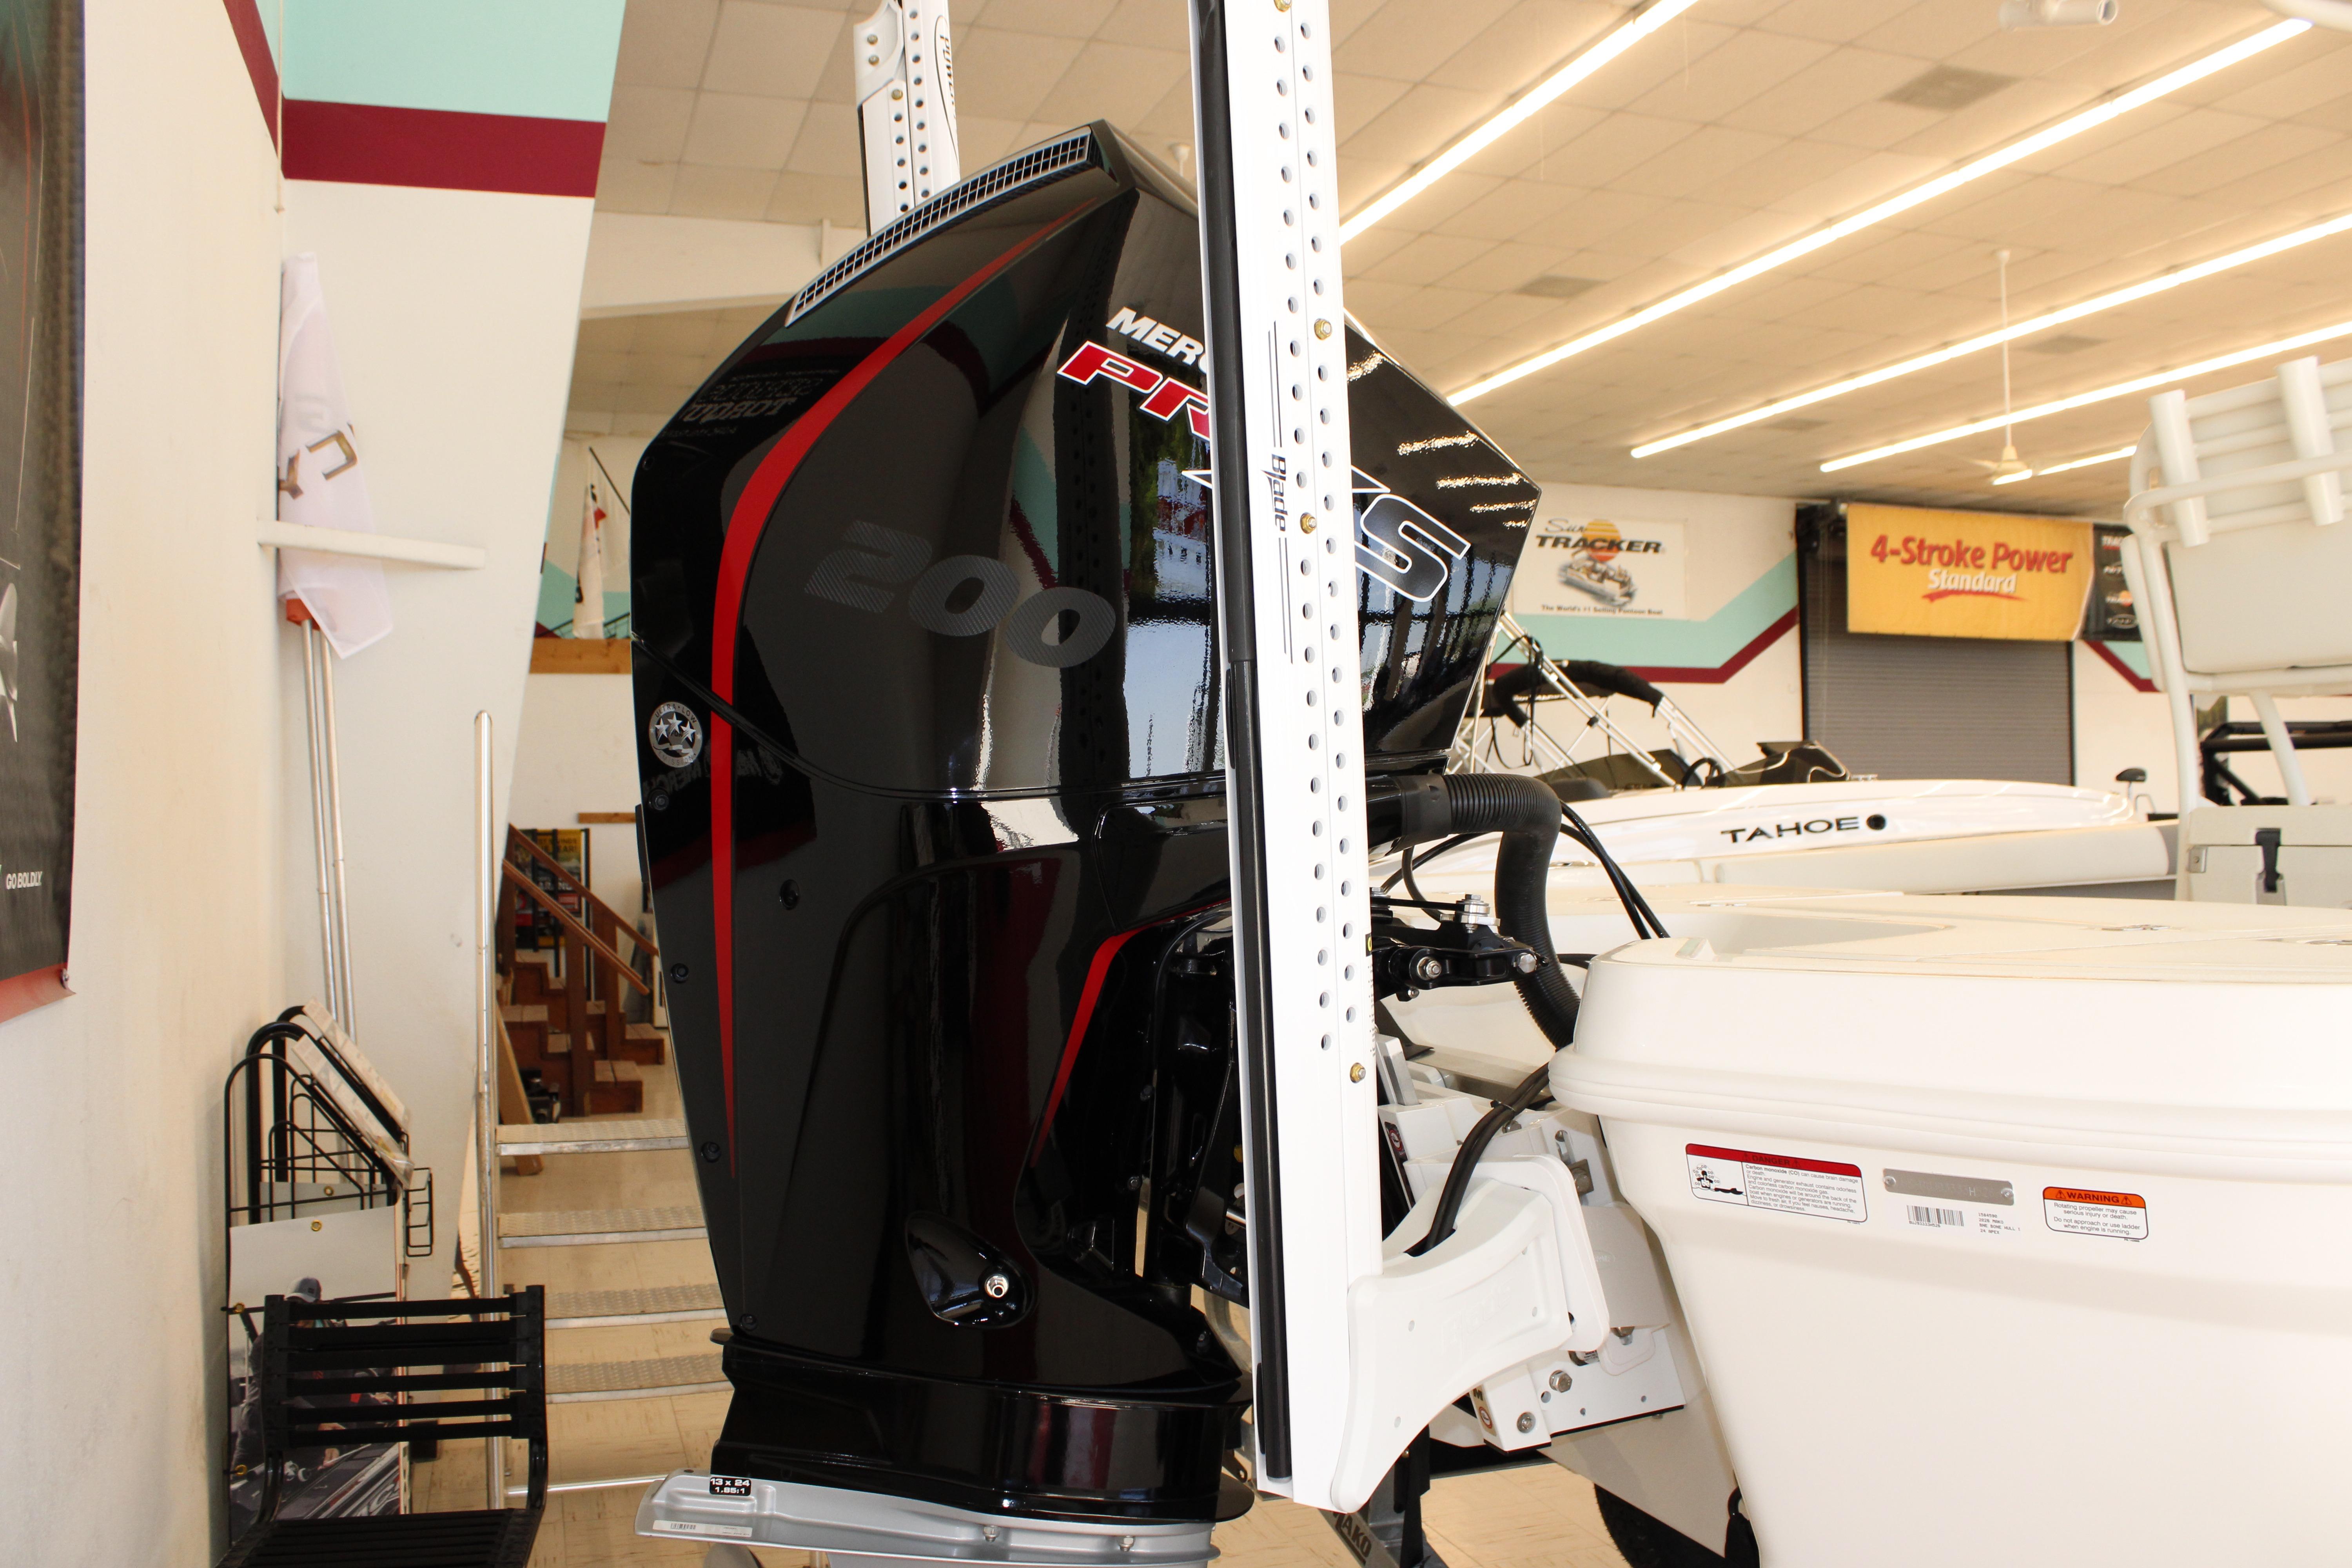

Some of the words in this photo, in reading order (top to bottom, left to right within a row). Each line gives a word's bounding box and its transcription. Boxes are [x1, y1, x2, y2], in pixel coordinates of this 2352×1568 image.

[1105, 306, 1207, 375] MER
[1261, 454, 1289, 532] Blade
[1545, 517, 1587, 533] Sun
[1536, 535, 1662, 554] TRACKER
[1871, 534, 1985, 570] 4-Stroke
[1991, 542, 2073, 573] Power
[1927, 568, 2018, 594] Standard
[804, 520, 1116, 668] 200
[655, 704, 676, 718] ULTRA
[682, 707, 697, 723] LOW
[1720, 817, 1859, 843] TAHOE
[6, 873, 17, 890] GO
[1752, 1155, 1790, 1165] DANGER
[2067, 1192, 2119, 1203] WARNING
